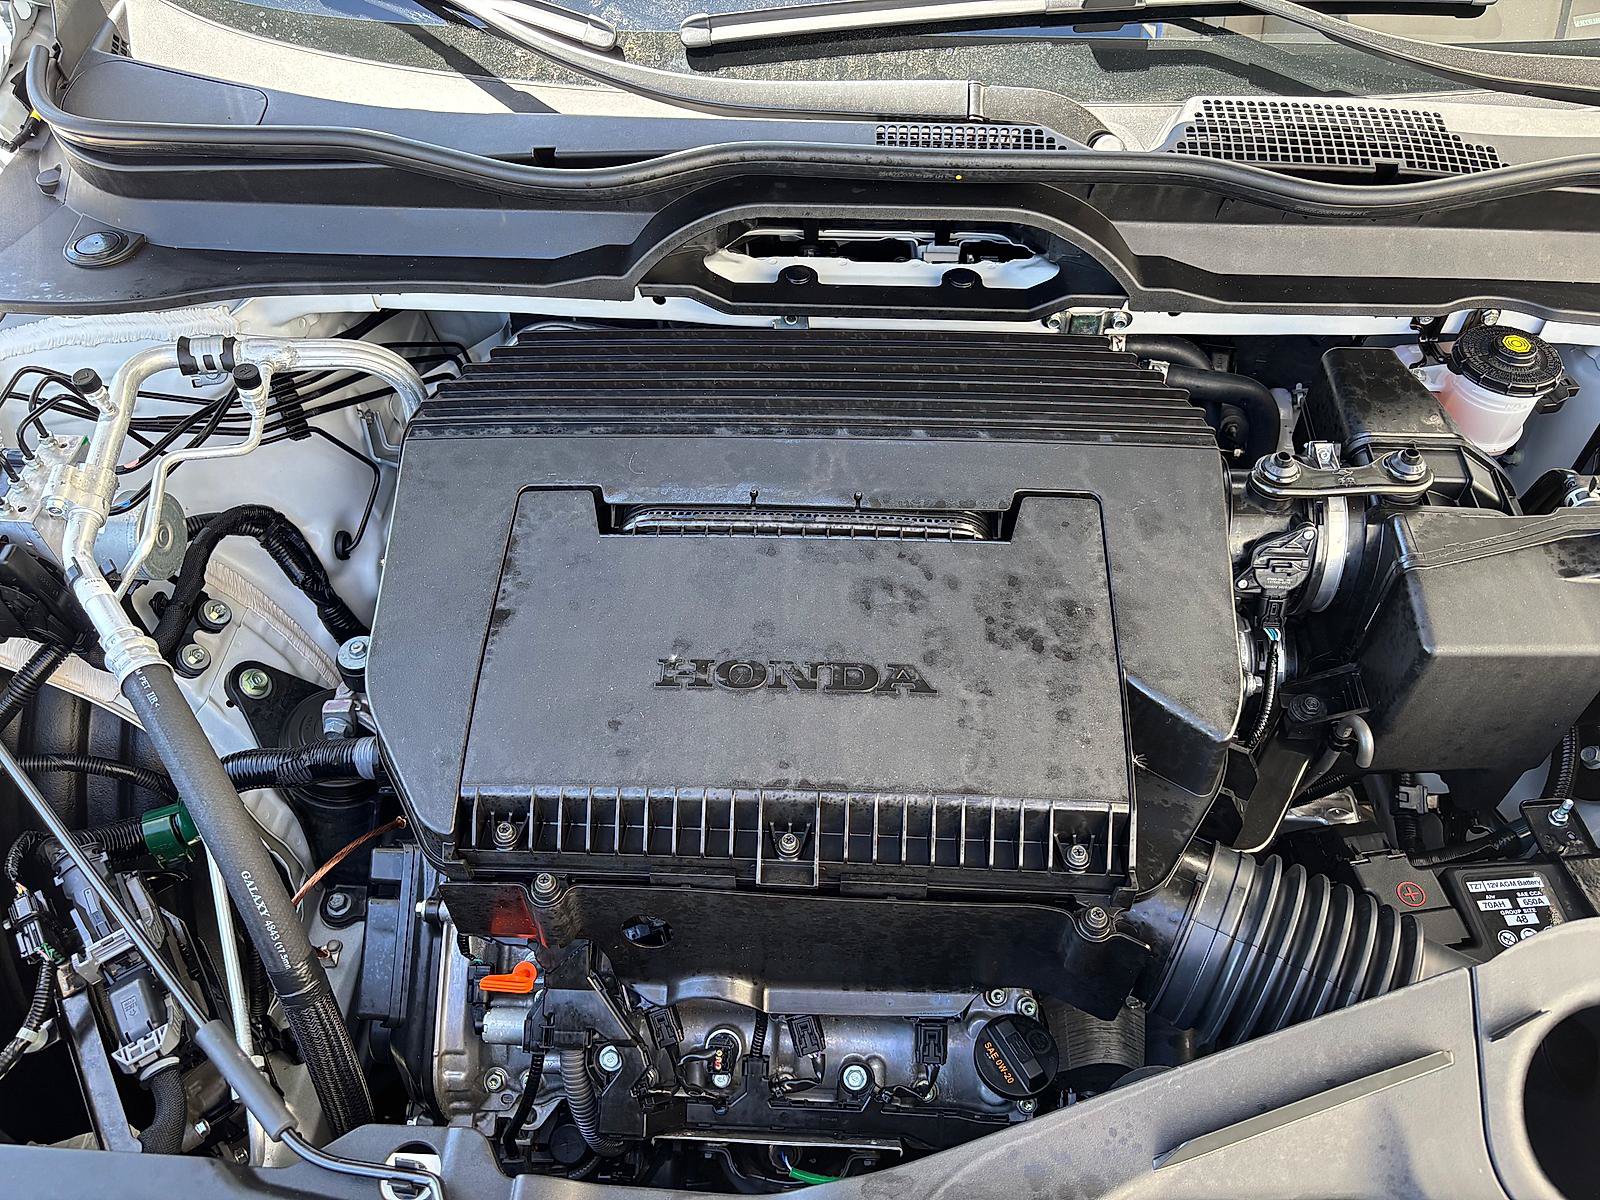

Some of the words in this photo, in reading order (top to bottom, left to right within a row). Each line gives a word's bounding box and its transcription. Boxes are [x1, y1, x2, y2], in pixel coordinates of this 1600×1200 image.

[139, 675, 151, 690] PET
[653, 658, 938, 695] HONDA
[1499, 880, 1517, 888] AGM
[1517, 879, 1541, 887] Battery
[241, 870, 271, 918] GALAXY
[265, 919, 281, 942] 4843
[1482, 900, 1506, 909] 70AH
[1523, 898, 1545, 906] 650A
[1516, 915, 1529, 923] 48
[984, 1041, 1000, 1060] SAE
[995, 1059, 1015, 1084] 0W-20
